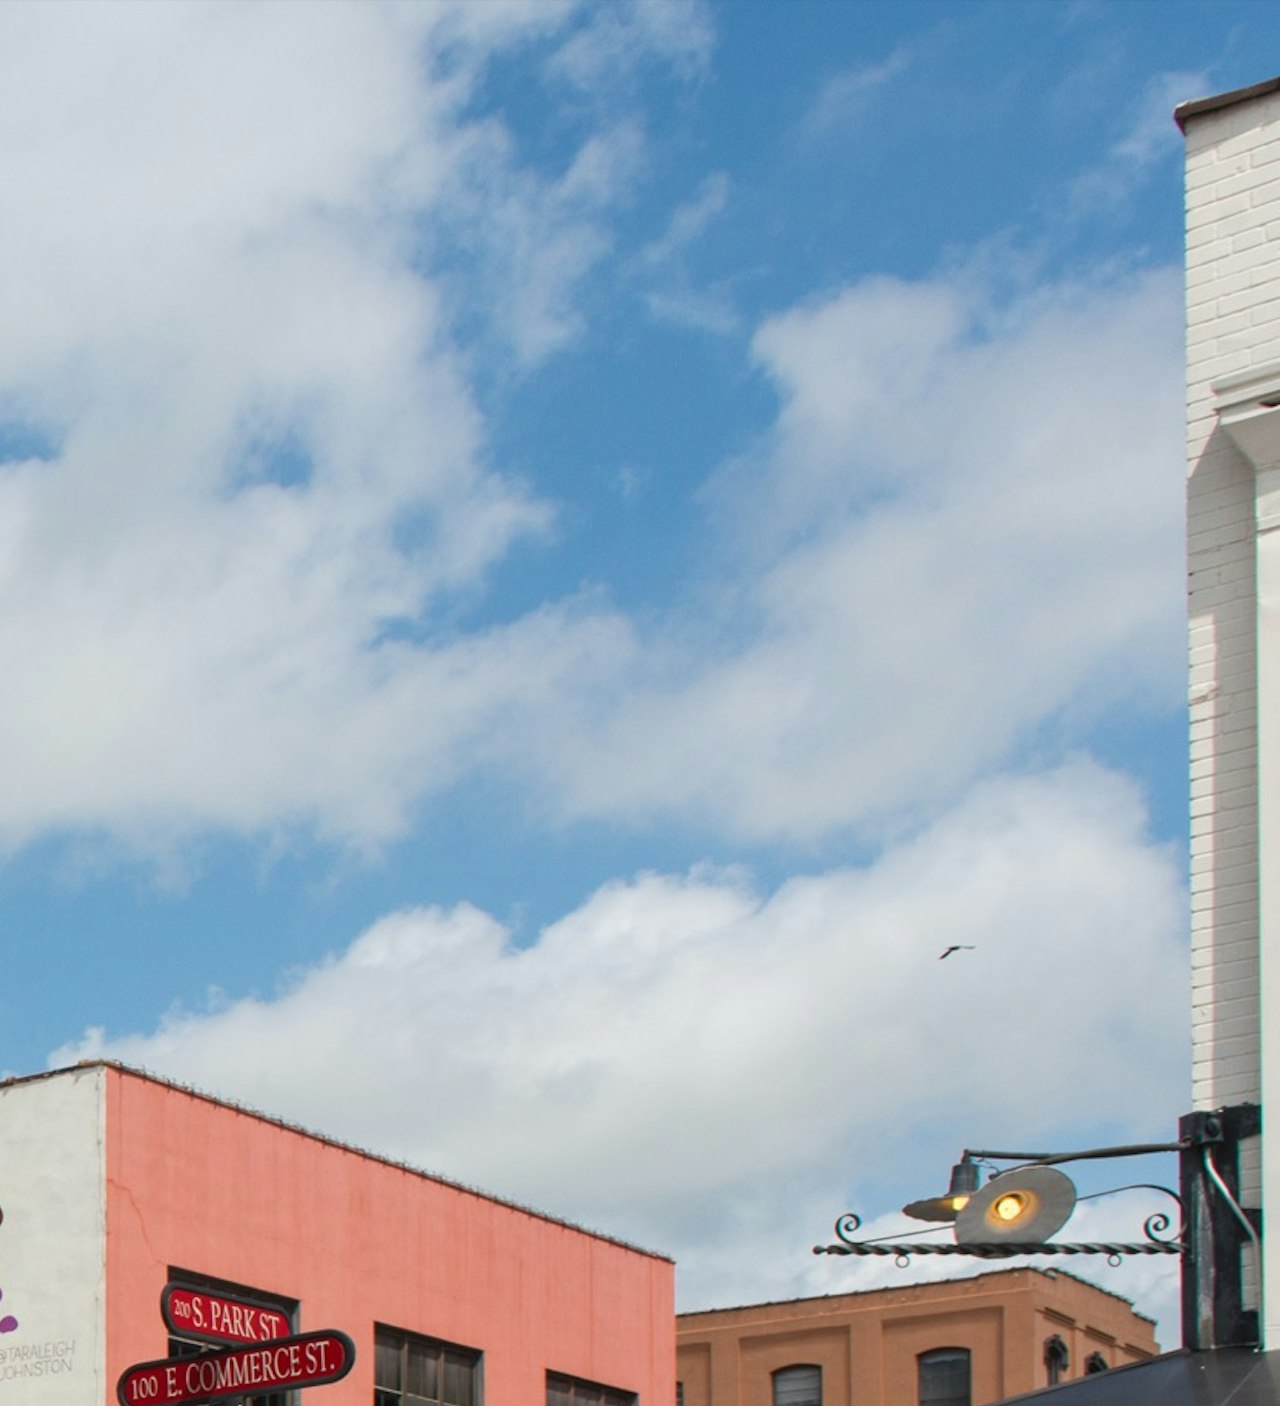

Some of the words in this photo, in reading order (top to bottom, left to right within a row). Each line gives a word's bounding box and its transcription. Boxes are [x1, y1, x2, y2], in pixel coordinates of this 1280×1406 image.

[174, 1299, 190, 1319] 200
[191, 1296, 208, 1329] S.
[210, 1301, 257, 1341] PARK
[132, 1376, 158, 1400] 100
[166, 1367, 183, 1398] E.
[185, 1345, 302, 1394] COMMERCE
[305, 1340, 336, 1375] ST.
